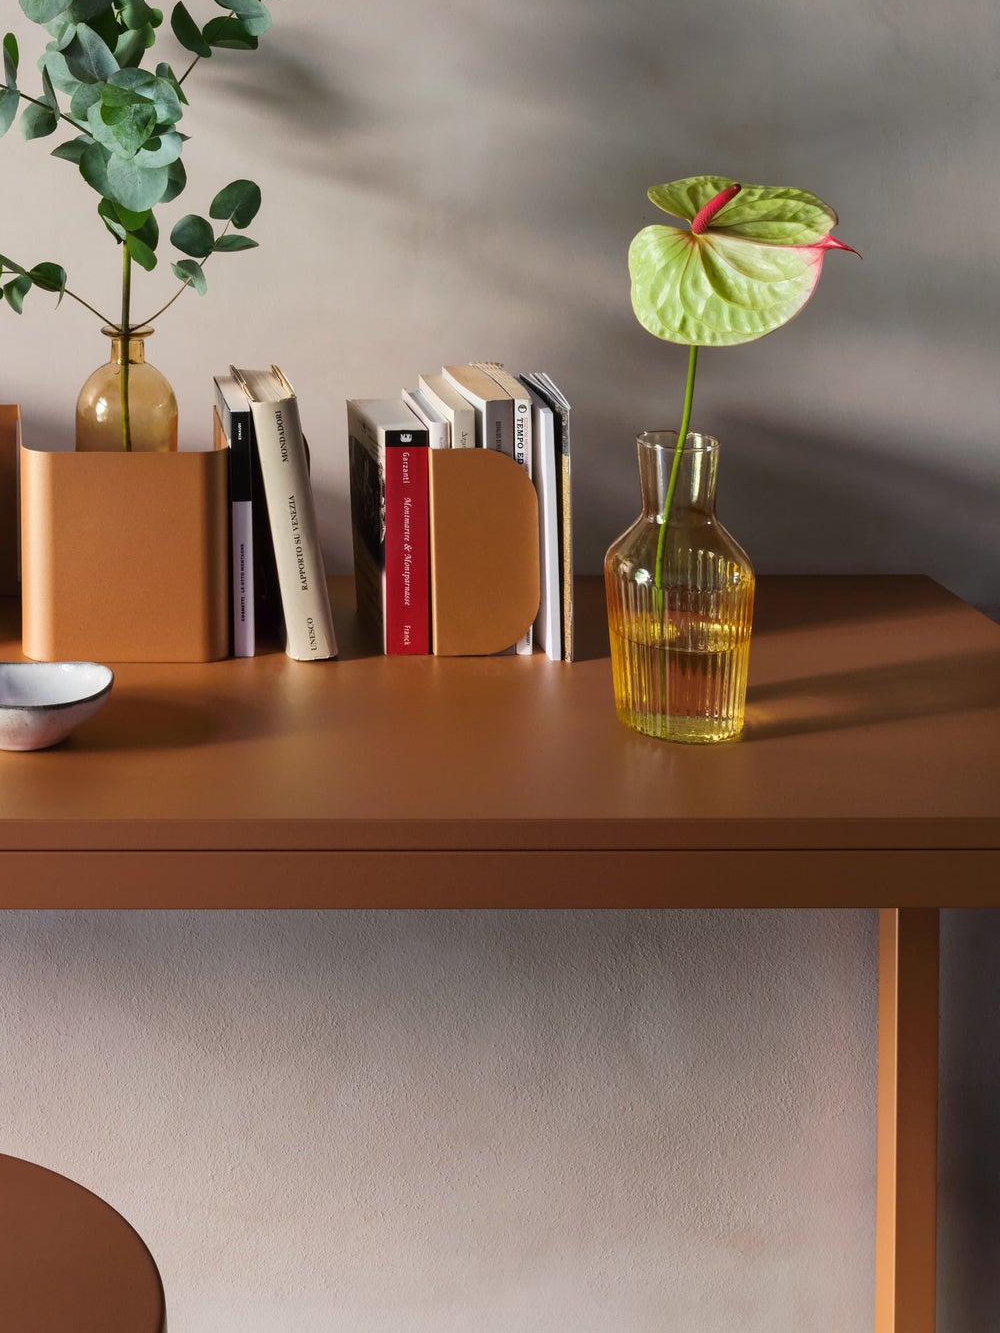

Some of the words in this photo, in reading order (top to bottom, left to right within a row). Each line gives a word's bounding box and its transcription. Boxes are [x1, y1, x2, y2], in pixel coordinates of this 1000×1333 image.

[275, 410, 289, 462] MONDADORI
[402, 452, 411, 484] Garzanti
[517, 452, 524, 465] ED
[288, 495, 299, 532] VENEZIA
[404, 497, 412, 541] Montmartre
[294, 533, 301, 545] SU
[404, 543, 412, 552] &
[295, 546, 308, 591] RAPPORTO
[402, 554, 413, 606] Montparnasse
[306, 617, 317, 651] UNESCO
